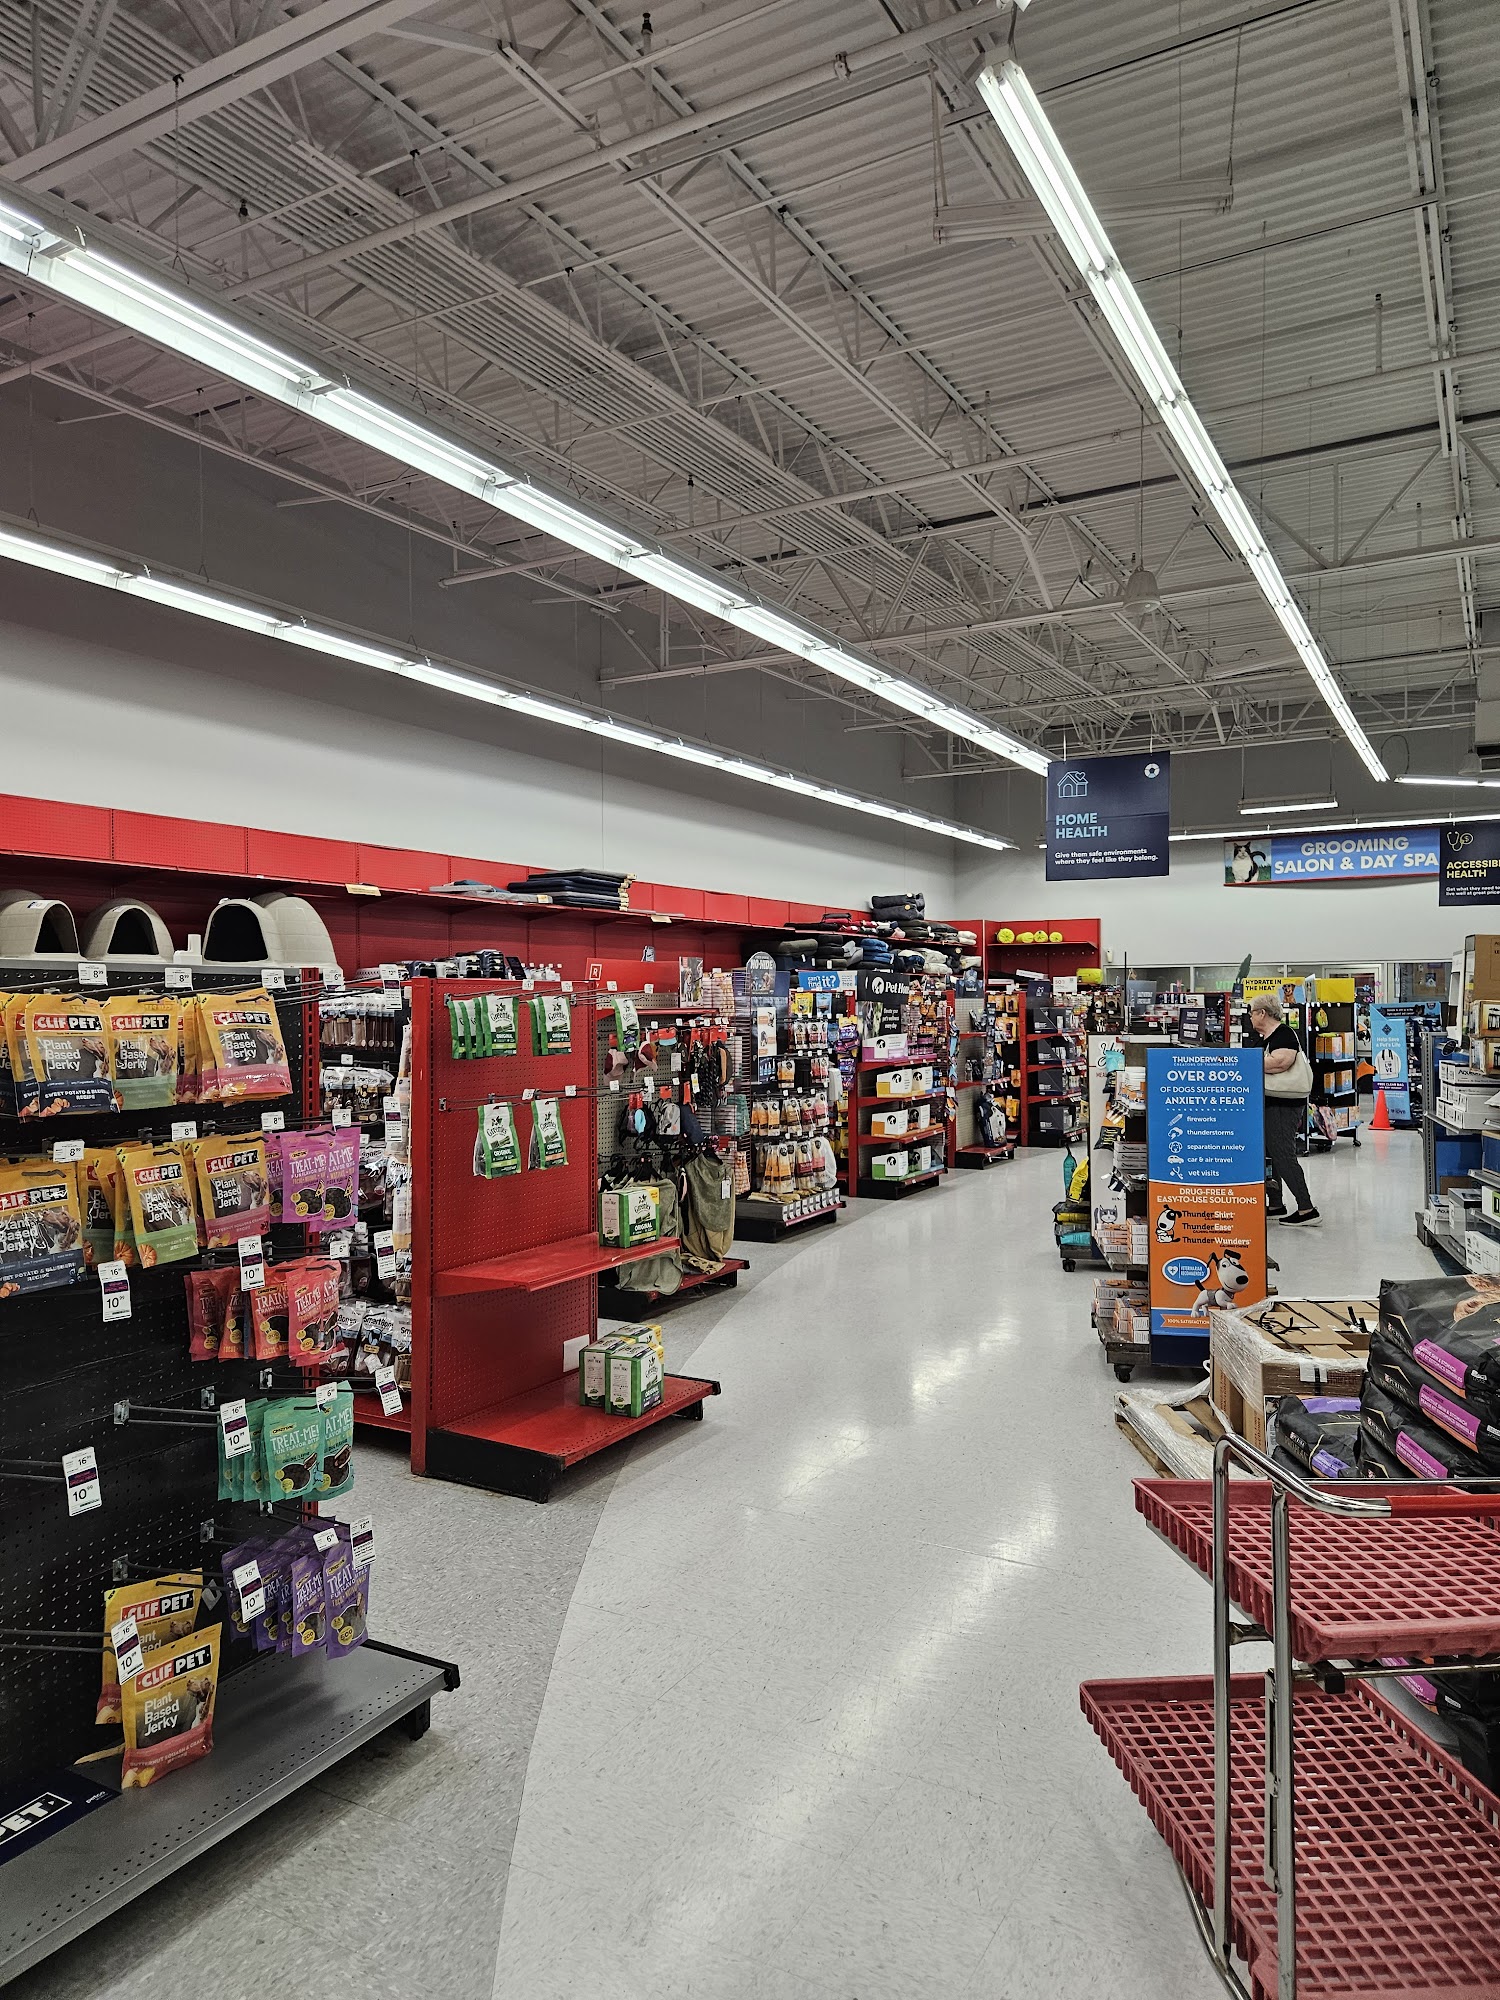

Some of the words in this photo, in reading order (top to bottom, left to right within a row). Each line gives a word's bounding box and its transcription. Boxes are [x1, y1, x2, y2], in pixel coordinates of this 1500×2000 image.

[1055, 812, 1098, 826] HOME
[1055, 825, 1108, 839] HEALTH
[1103, 848, 1147, 857] environments
[1301, 837, 1408, 856] GROOMING
[1076, 857, 1090, 865] they
[1118, 855, 1132, 863] they
[1134, 854, 1159, 862] belong.
[1274, 858, 1334, 875] SALON
[1340, 856, 1354, 870] &
[1360, 854, 1398, 869] DAY
[1403, 853, 1439, 867] SPA
[1446, 869, 1487, 879] HEALTH
[750, 960, 774, 970] NO-HIDE
[822, 976, 836, 988] it?
[885, 981, 898, 993] Pet
[36, 1016, 68, 1029] CLIF
[69, 1018, 96, 1029] PET
[116, 1016, 142, 1029] CLIF
[142, 1017, 166, 1028] PET
[218, 1012, 243, 1024] CLIF
[245, 1012, 267, 1023] PET
[45, 1040, 72, 1050] Plant
[226, 1040, 256, 1050] Based
[47, 1050, 81, 1060] Based
[120, 1050, 148, 1060] Based
[228, 1048, 257, 1059] Jerky
[49, 1060, 80, 1072] Jerky
[121, 1059, 147, 1070] Jerky
[1167, 1071, 1205, 1081] OVER
[1208, 1071, 1243, 1081] 80%
[44, 1090, 64, 1099] SWEET
[1165, 1097, 1208, 1105] ANXIETY
[1210, 1097, 1217, 1105] &
[1220, 1097, 1245, 1105] FEAR
[210, 1157, 232, 1171] CLIF
[234, 1152, 254, 1166] PET
[139, 1167, 160, 1181] CLIF
[161, 1166, 180, 1179] PET
[215, 1178, 236, 1190] Plant
[145, 1190, 165, 1203] Plant
[217, 1186, 241, 1199] Based
[1179, 1188, 1226, 1196] DRUG-FREE
[218, 1196, 241, 1209] Jerky
[1209, 1196, 1258, 1204] SOLUTIONS
[147, 1200, 171, 1213] Based
[149, 1210, 173, 1223] Jerky
[27, 1272, 50, 1282] RECIPE
[1449, 1412, 1469, 1426] STOMACH
[270, 1425, 320, 1450] TREAT-ME!
[161, 1593, 190, 1614] PET
[141, 1661, 173, 1688] CLIF
[175, 1651, 205, 1674] PET
[144, 1691, 172, 1712] Plant
[144, 1699, 179, 1724] Based
[144, 1717, 178, 1737] Jerky
[130, 1754, 163, 1767] BUTTERNUT
[165, 1748, 186, 1760] SQUASH
